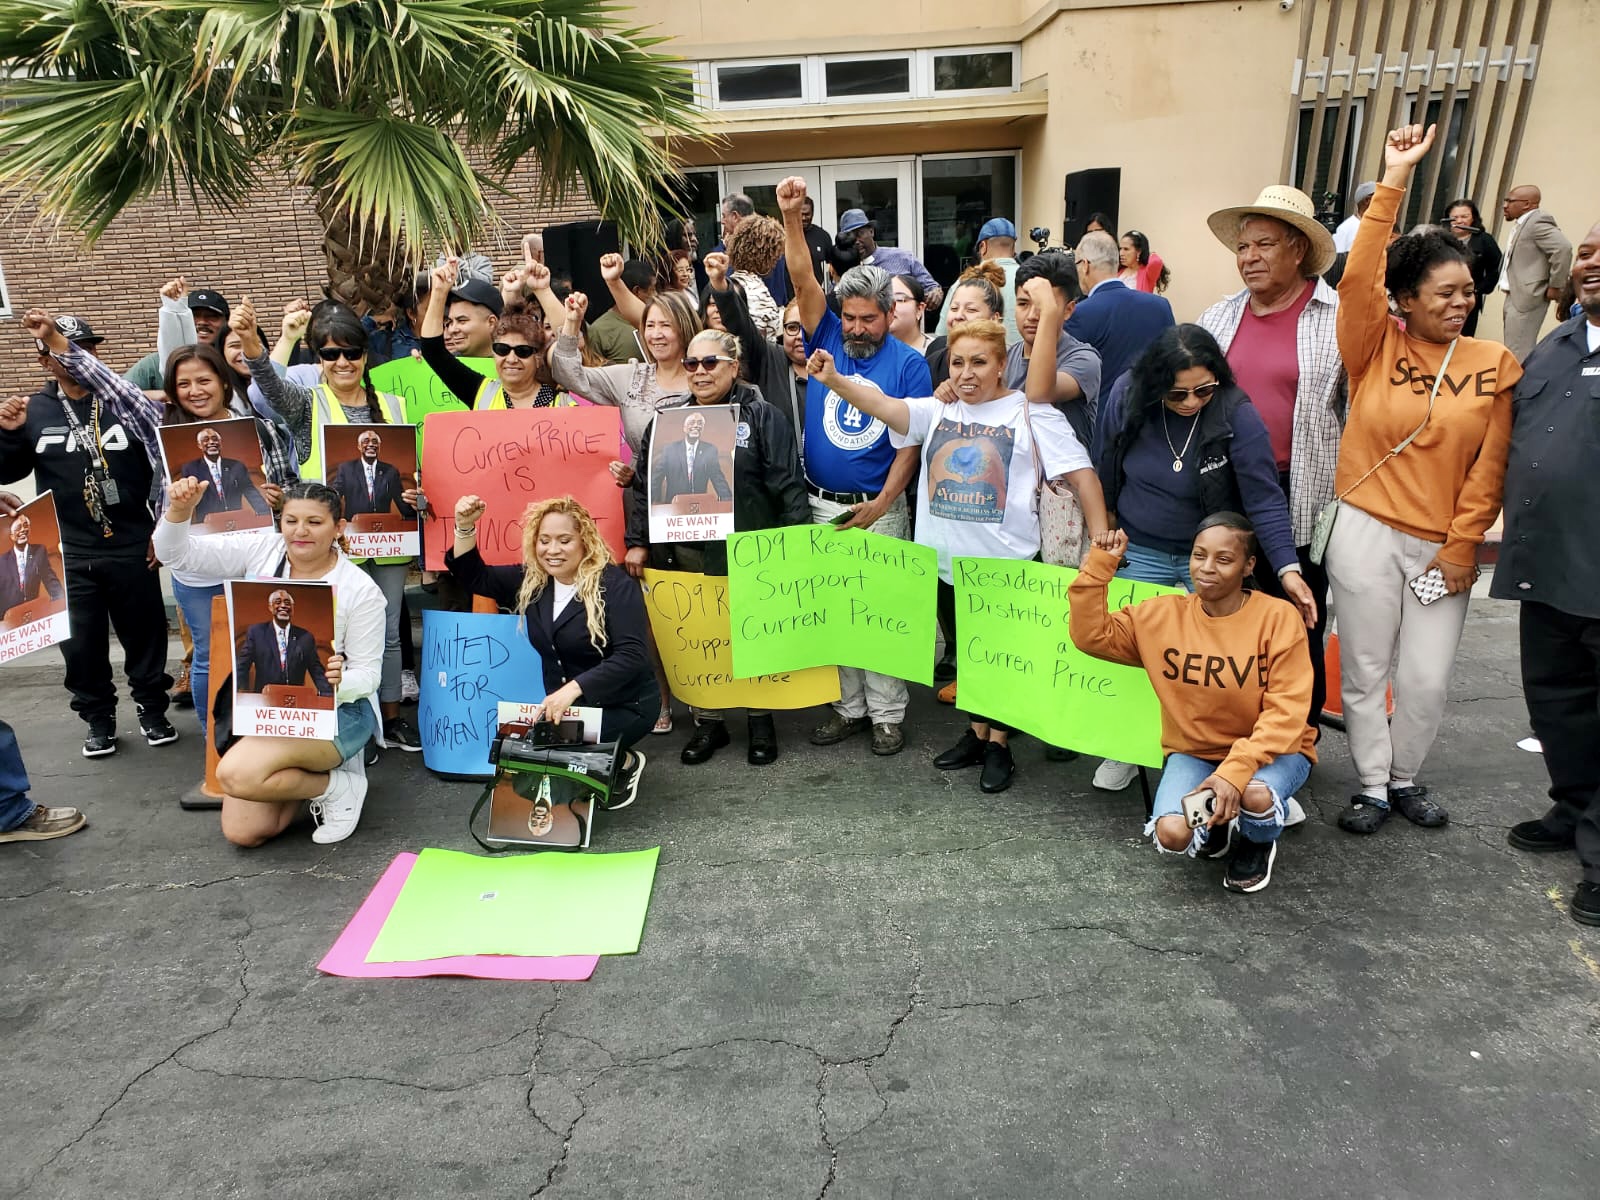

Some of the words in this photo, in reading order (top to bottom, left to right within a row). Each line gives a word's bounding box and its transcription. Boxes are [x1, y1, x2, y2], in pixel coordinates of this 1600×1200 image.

[1390, 357, 1497, 397] SERVE
[35, 423, 129, 454] FIA
[828, 420, 875, 445] FOUNDATION
[941, 487, 986, 505] Youth
[667, 517, 684, 527] WE
[686, 516, 719, 526] WANT
[667, 531, 699, 540] PRICE
[702, 529, 720, 539] JR.
[346, 534, 365, 545] WE
[368, 533, 404, 545] WANT
[386, 546, 405, 556] JR.
[733, 532, 786, 568] CD9
[809, 528, 926, 576] Residents
[652, 580, 706, 622] CD9
[756, 569, 870, 609] Support
[850, 598, 911, 635] Price
[968, 593, 1052, 628] Distrito
[0, 634, 17, 646] WE
[19, 618, 53, 639] WANT
[676, 627, 730, 660] Suppo
[0, 640, 34, 660] PRICE
[37, 634, 55, 648] JR.
[967, 637, 1034, 675] Curren
[1053, 659, 1117, 697] Price
[1162, 647, 1268, 689] SERVE
[449, 673, 505, 703] FOR
[255, 708, 277, 720] WE
[279, 710, 319, 722] WANT
[255, 724, 296, 736] PRICE
[299, 726, 319, 738] JR.
[567, 763, 588, 775] PYLE
